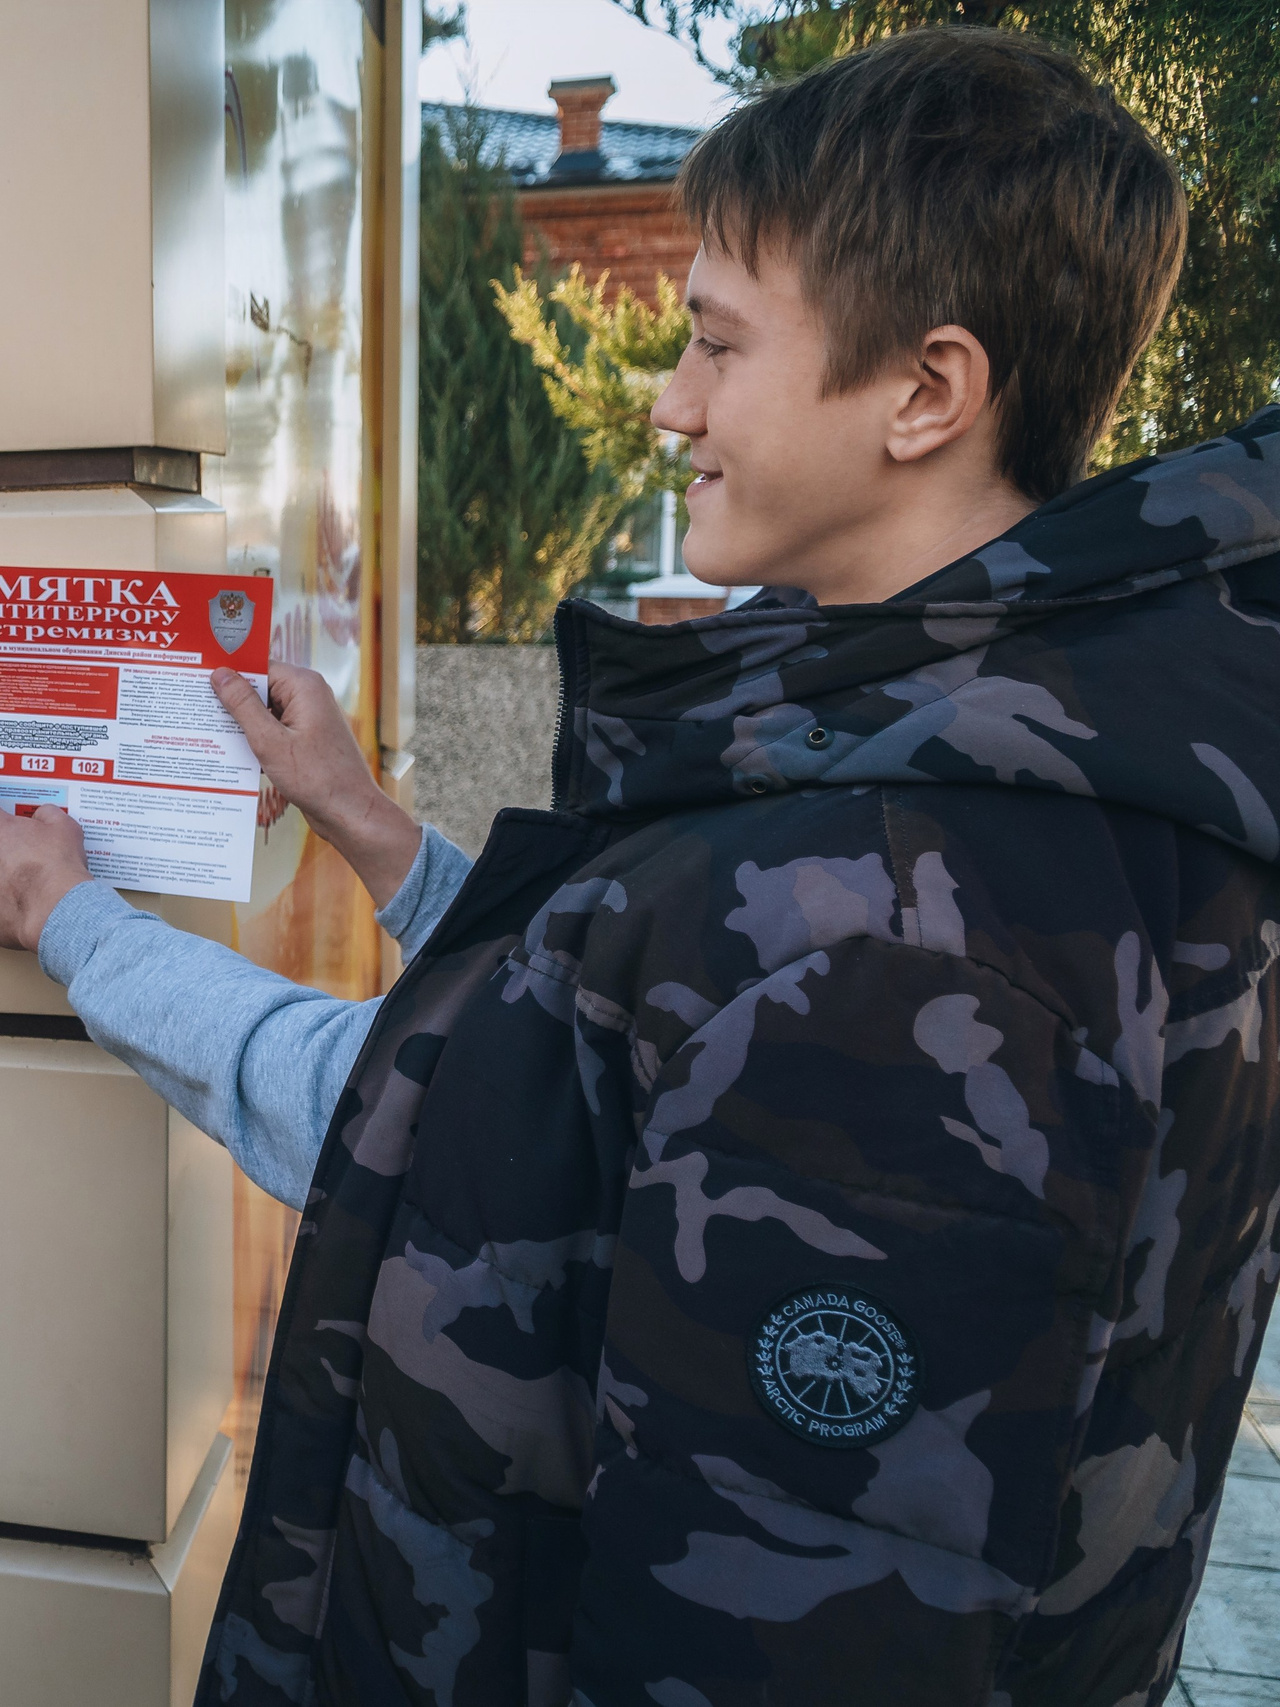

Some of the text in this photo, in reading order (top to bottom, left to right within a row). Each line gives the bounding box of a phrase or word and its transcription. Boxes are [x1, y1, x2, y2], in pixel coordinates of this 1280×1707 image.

[8, 646, 61, 655] муниципальном
[62, 648, 102, 656] образования
[104, 649, 131, 657] Динской
[132, 651, 152, 659] район
[153, 652, 198, 662] информирует
[27, 758, 49, 770] 112
[78, 762, 99, 774] 102
[782, 1293, 902, 1344] CANADA GOOSE
[762, 1379, 888, 1438] ARCTIC PROGRAM
